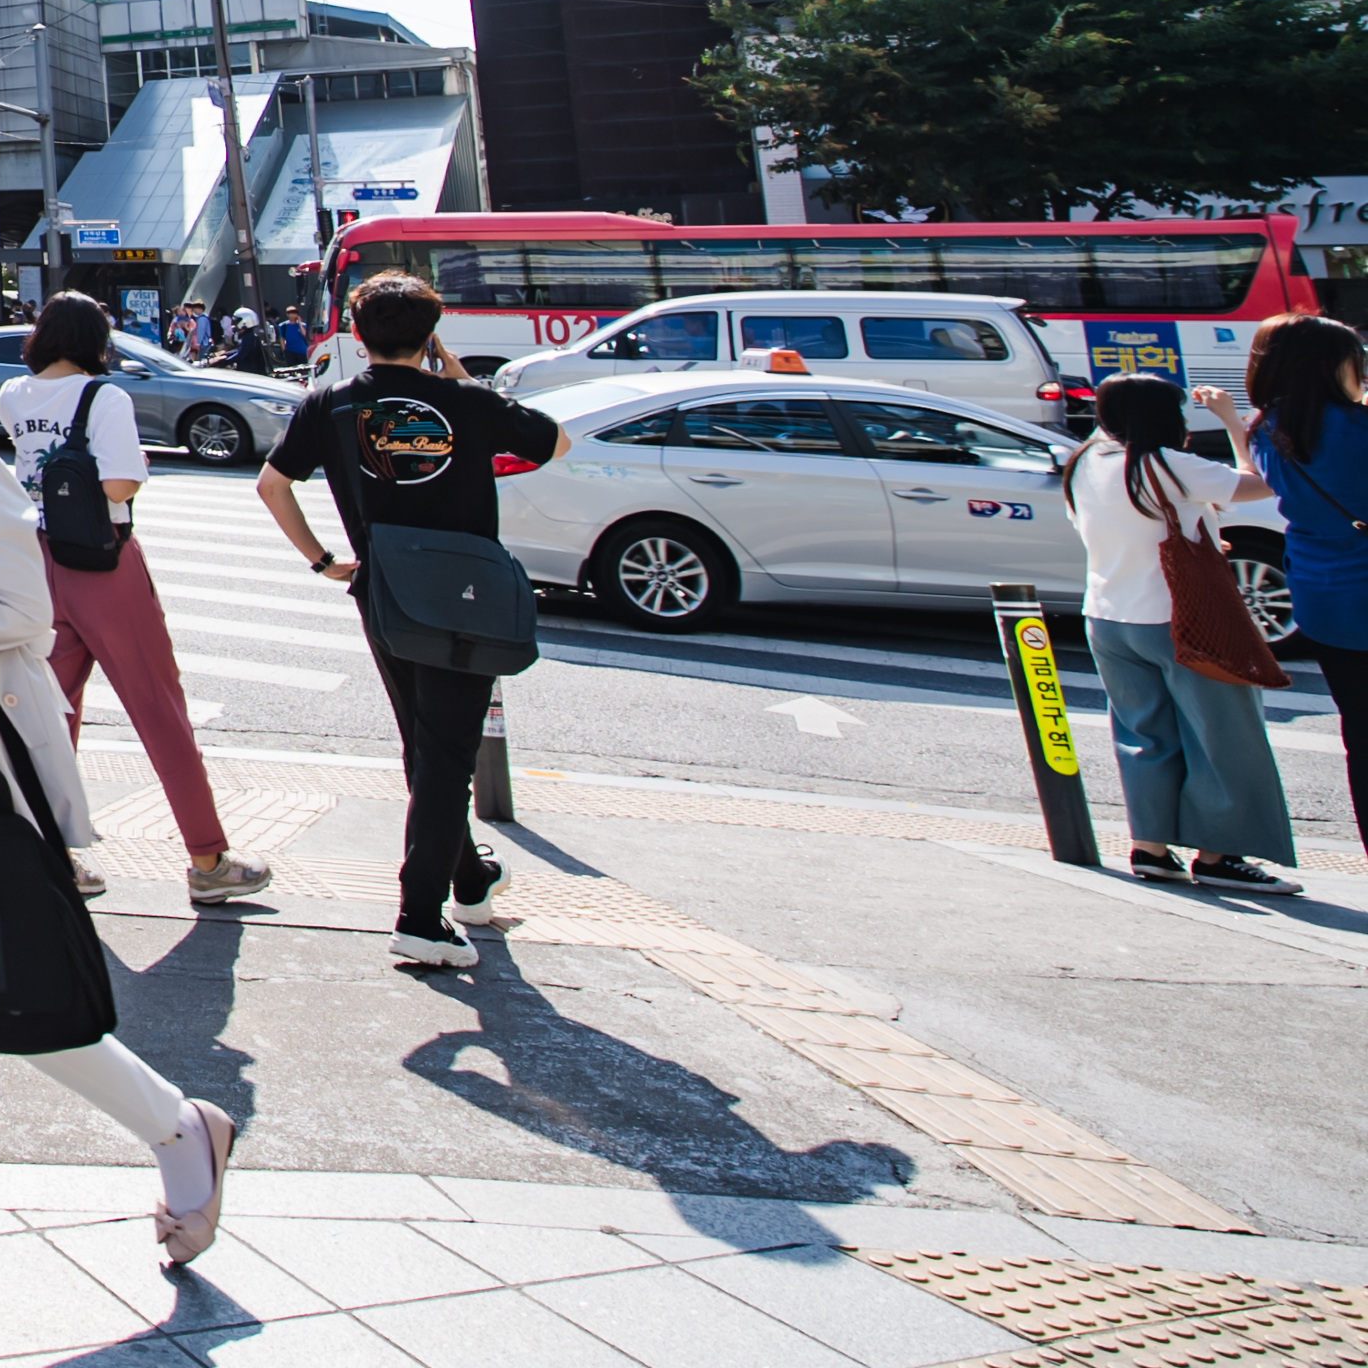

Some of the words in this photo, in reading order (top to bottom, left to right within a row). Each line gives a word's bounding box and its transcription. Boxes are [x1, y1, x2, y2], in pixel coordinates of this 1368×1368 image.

[132, 291, 156, 300] VISIT
[1091, 345, 1181, 375] 태화
[25, 418, 72, 440] BEAC
[375, 436, 412, 451] Cotton
[411, 435, 449, 451] Basic
[1029, 655, 1072, 753] 금연구역
